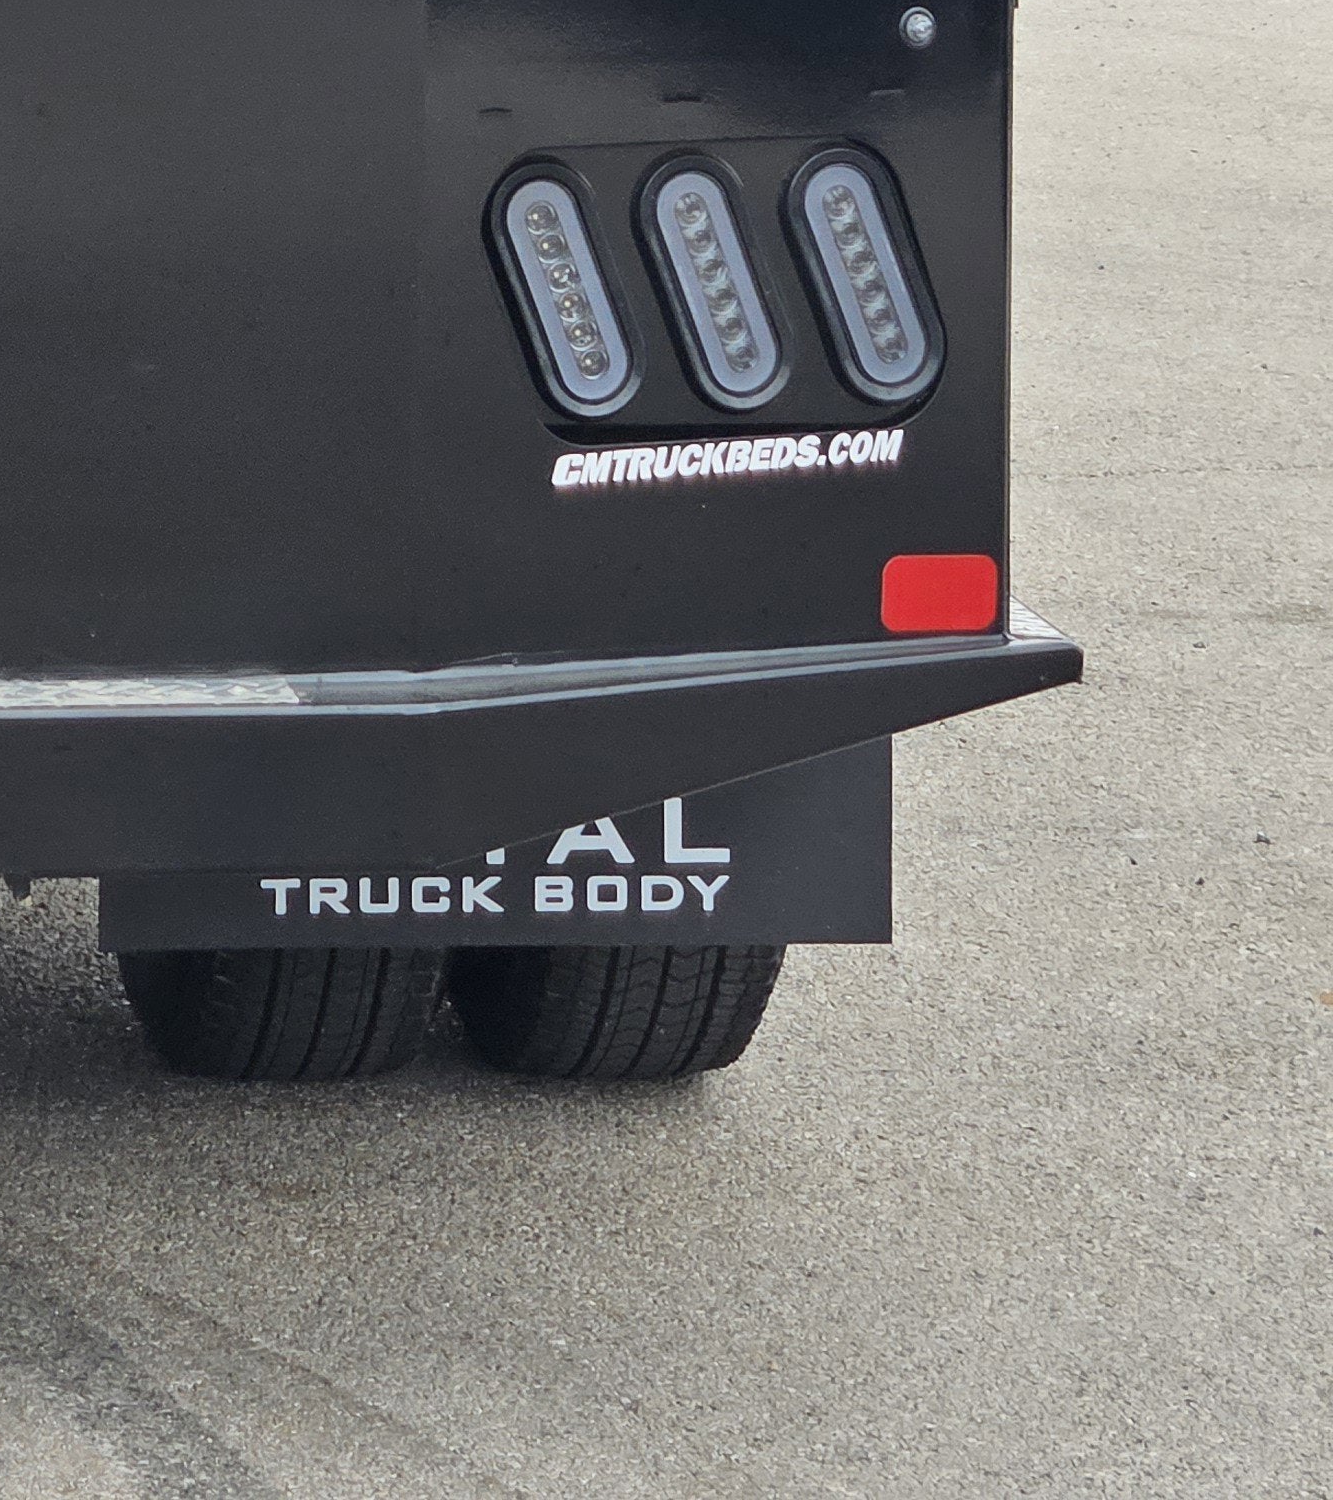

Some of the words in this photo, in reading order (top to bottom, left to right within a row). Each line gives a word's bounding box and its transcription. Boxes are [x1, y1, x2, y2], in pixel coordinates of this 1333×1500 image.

[551, 428, 905, 486] CMTRUCKBEDS.COM
[260, 875, 505, 915] TRUCK
[534, 874, 730, 913] BODY
